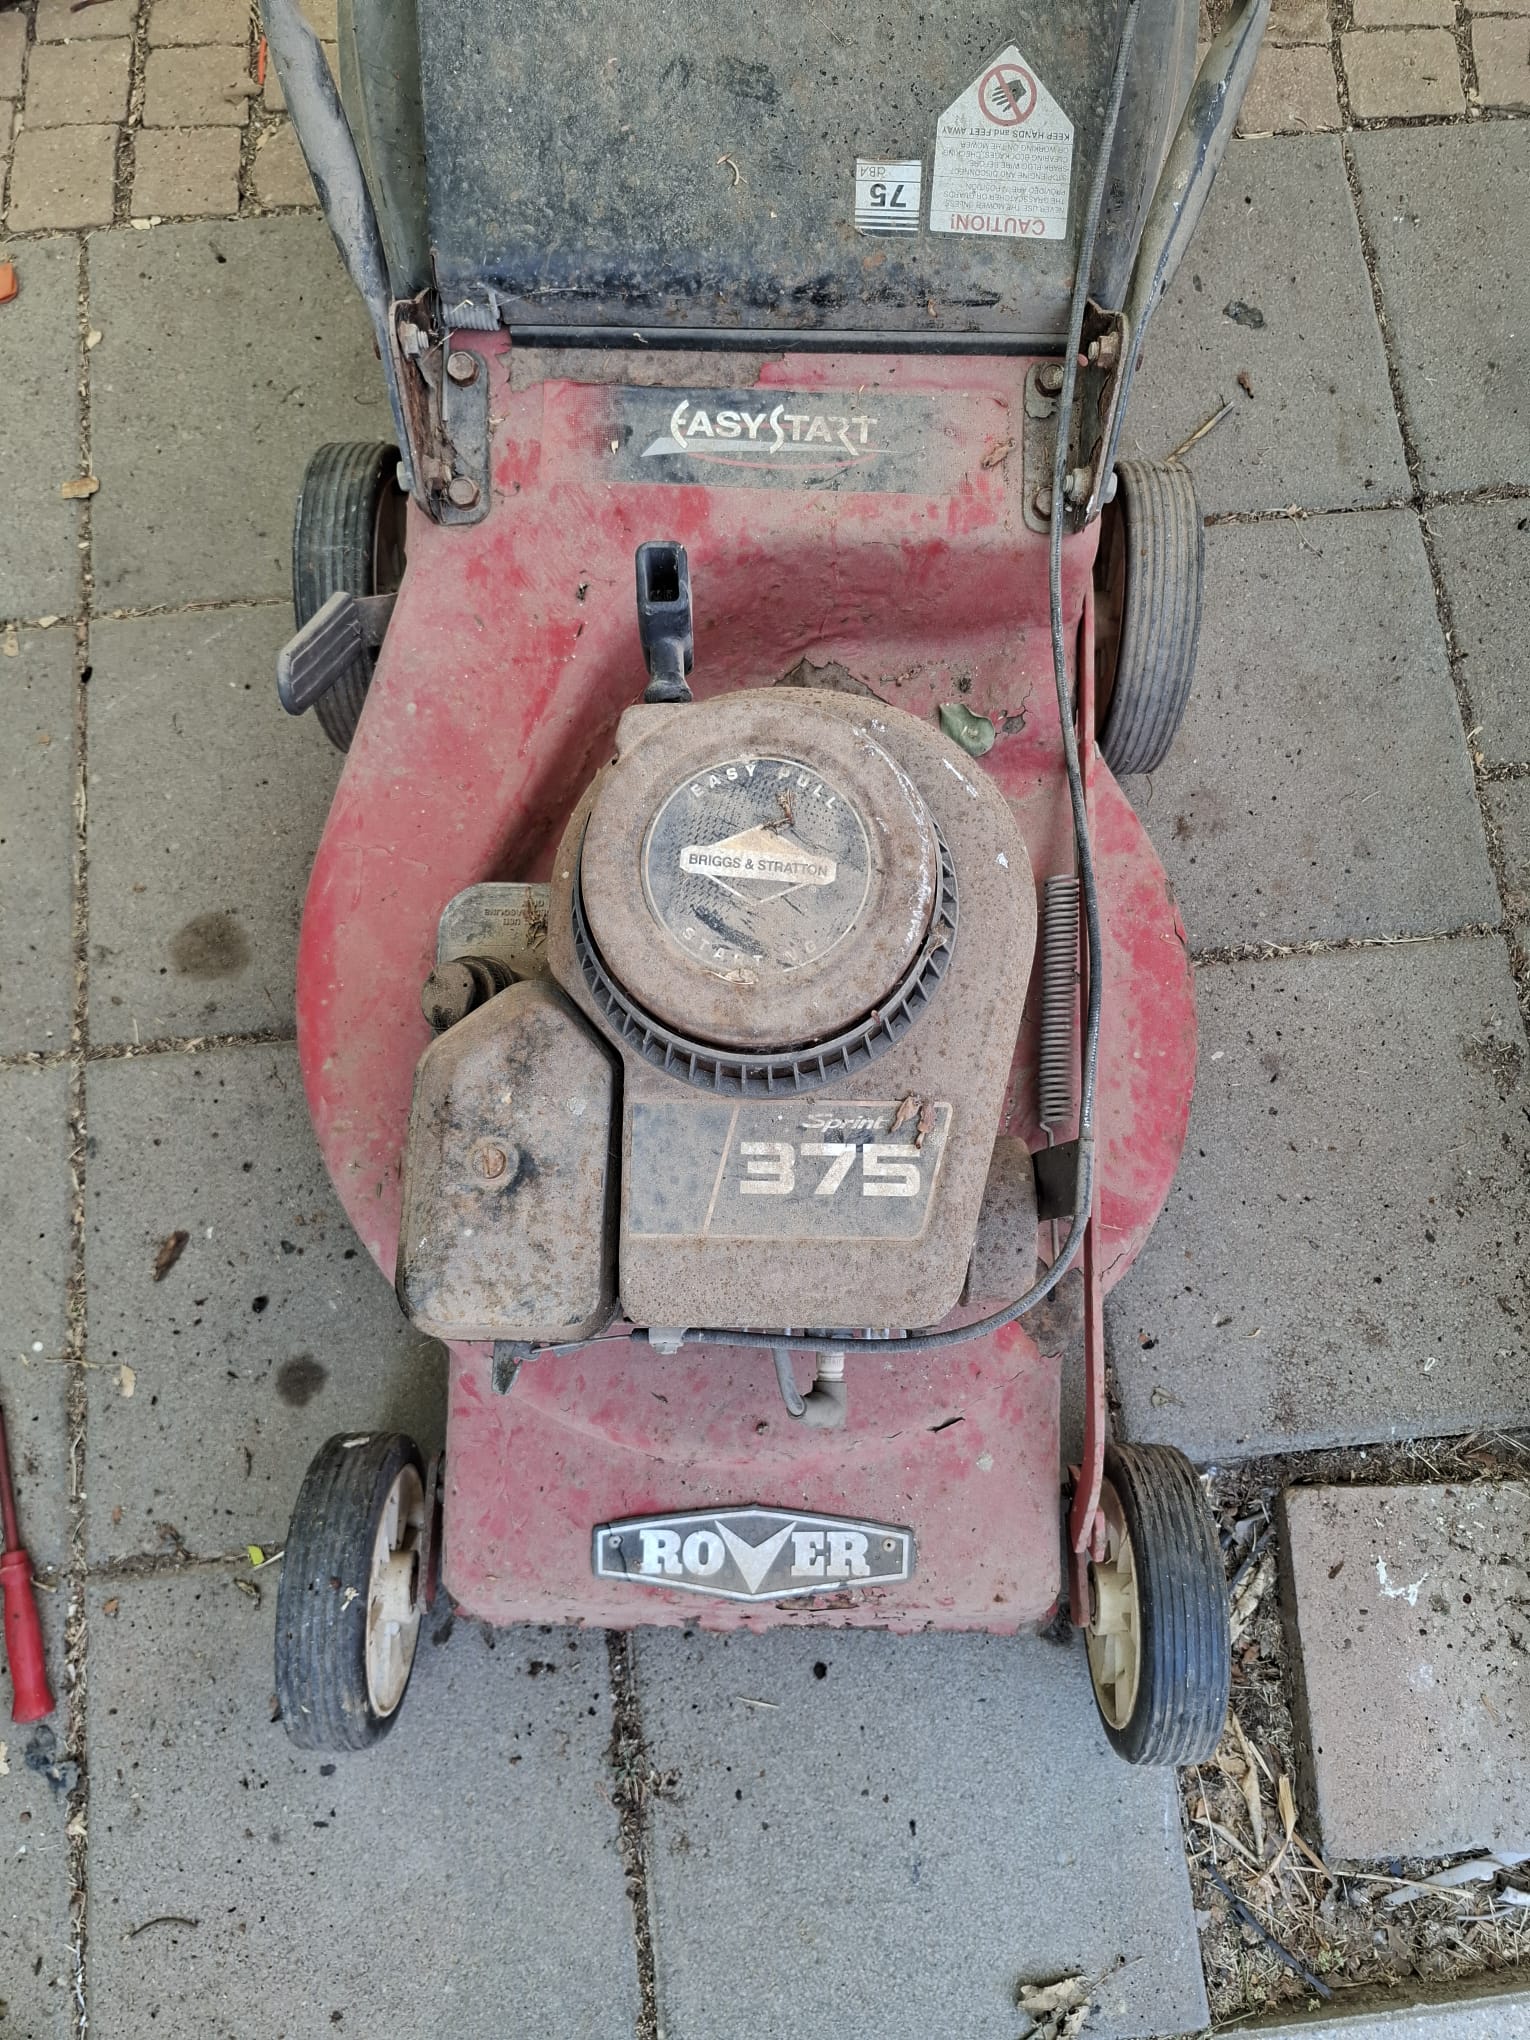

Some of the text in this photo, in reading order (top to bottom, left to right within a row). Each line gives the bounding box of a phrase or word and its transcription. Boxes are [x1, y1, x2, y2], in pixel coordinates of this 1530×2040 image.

[942, 126, 966, 134] AWAY
[969, 128, 991, 136] FEET
[994, 129, 1009, 137] and
[859, 166, 885, 178] dBA
[870, 184, 906, 207] 75
[950, 214, 1045, 236] CAUTION!
[691, 764, 837, 810] EASY PULL
[688, 853, 828, 876] BRIGGS & STRATTON
[802, 1112, 891, 1133] Sprint
[740, 1141, 921, 1197] 375
[639, 1520, 871, 1594] ROVER
